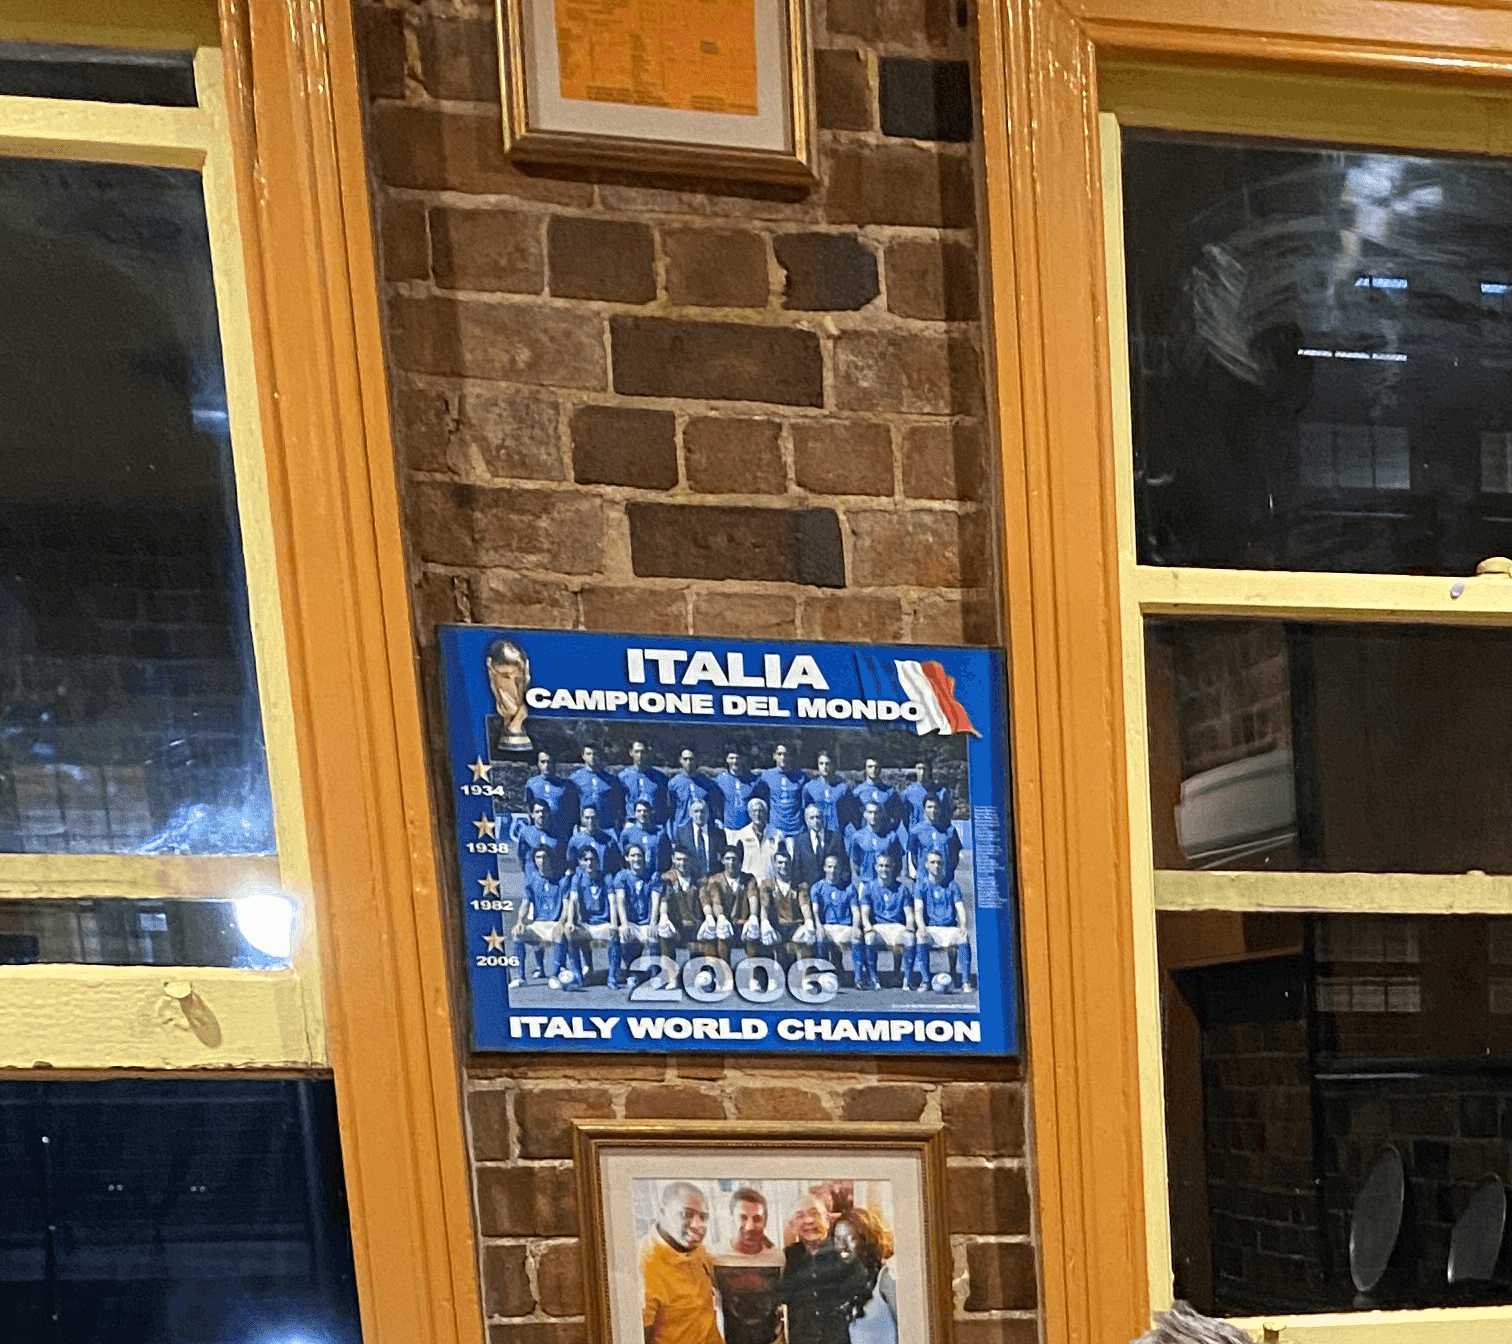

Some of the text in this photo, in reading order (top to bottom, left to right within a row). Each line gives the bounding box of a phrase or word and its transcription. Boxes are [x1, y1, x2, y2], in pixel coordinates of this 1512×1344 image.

[626, 648, 829, 690] ITALIA
[526, 687, 926, 722] CAMPIONE DEL MONDO
[460, 783, 505, 797] 1934
[466, 841, 509, 855] 1938
[470, 899, 514, 912] 1982
[476, 955, 520, 968] 2006
[627, 955, 839, 1004] 2006
[509, 1015, 982, 1043] ITALY WORLD CHAMPION
